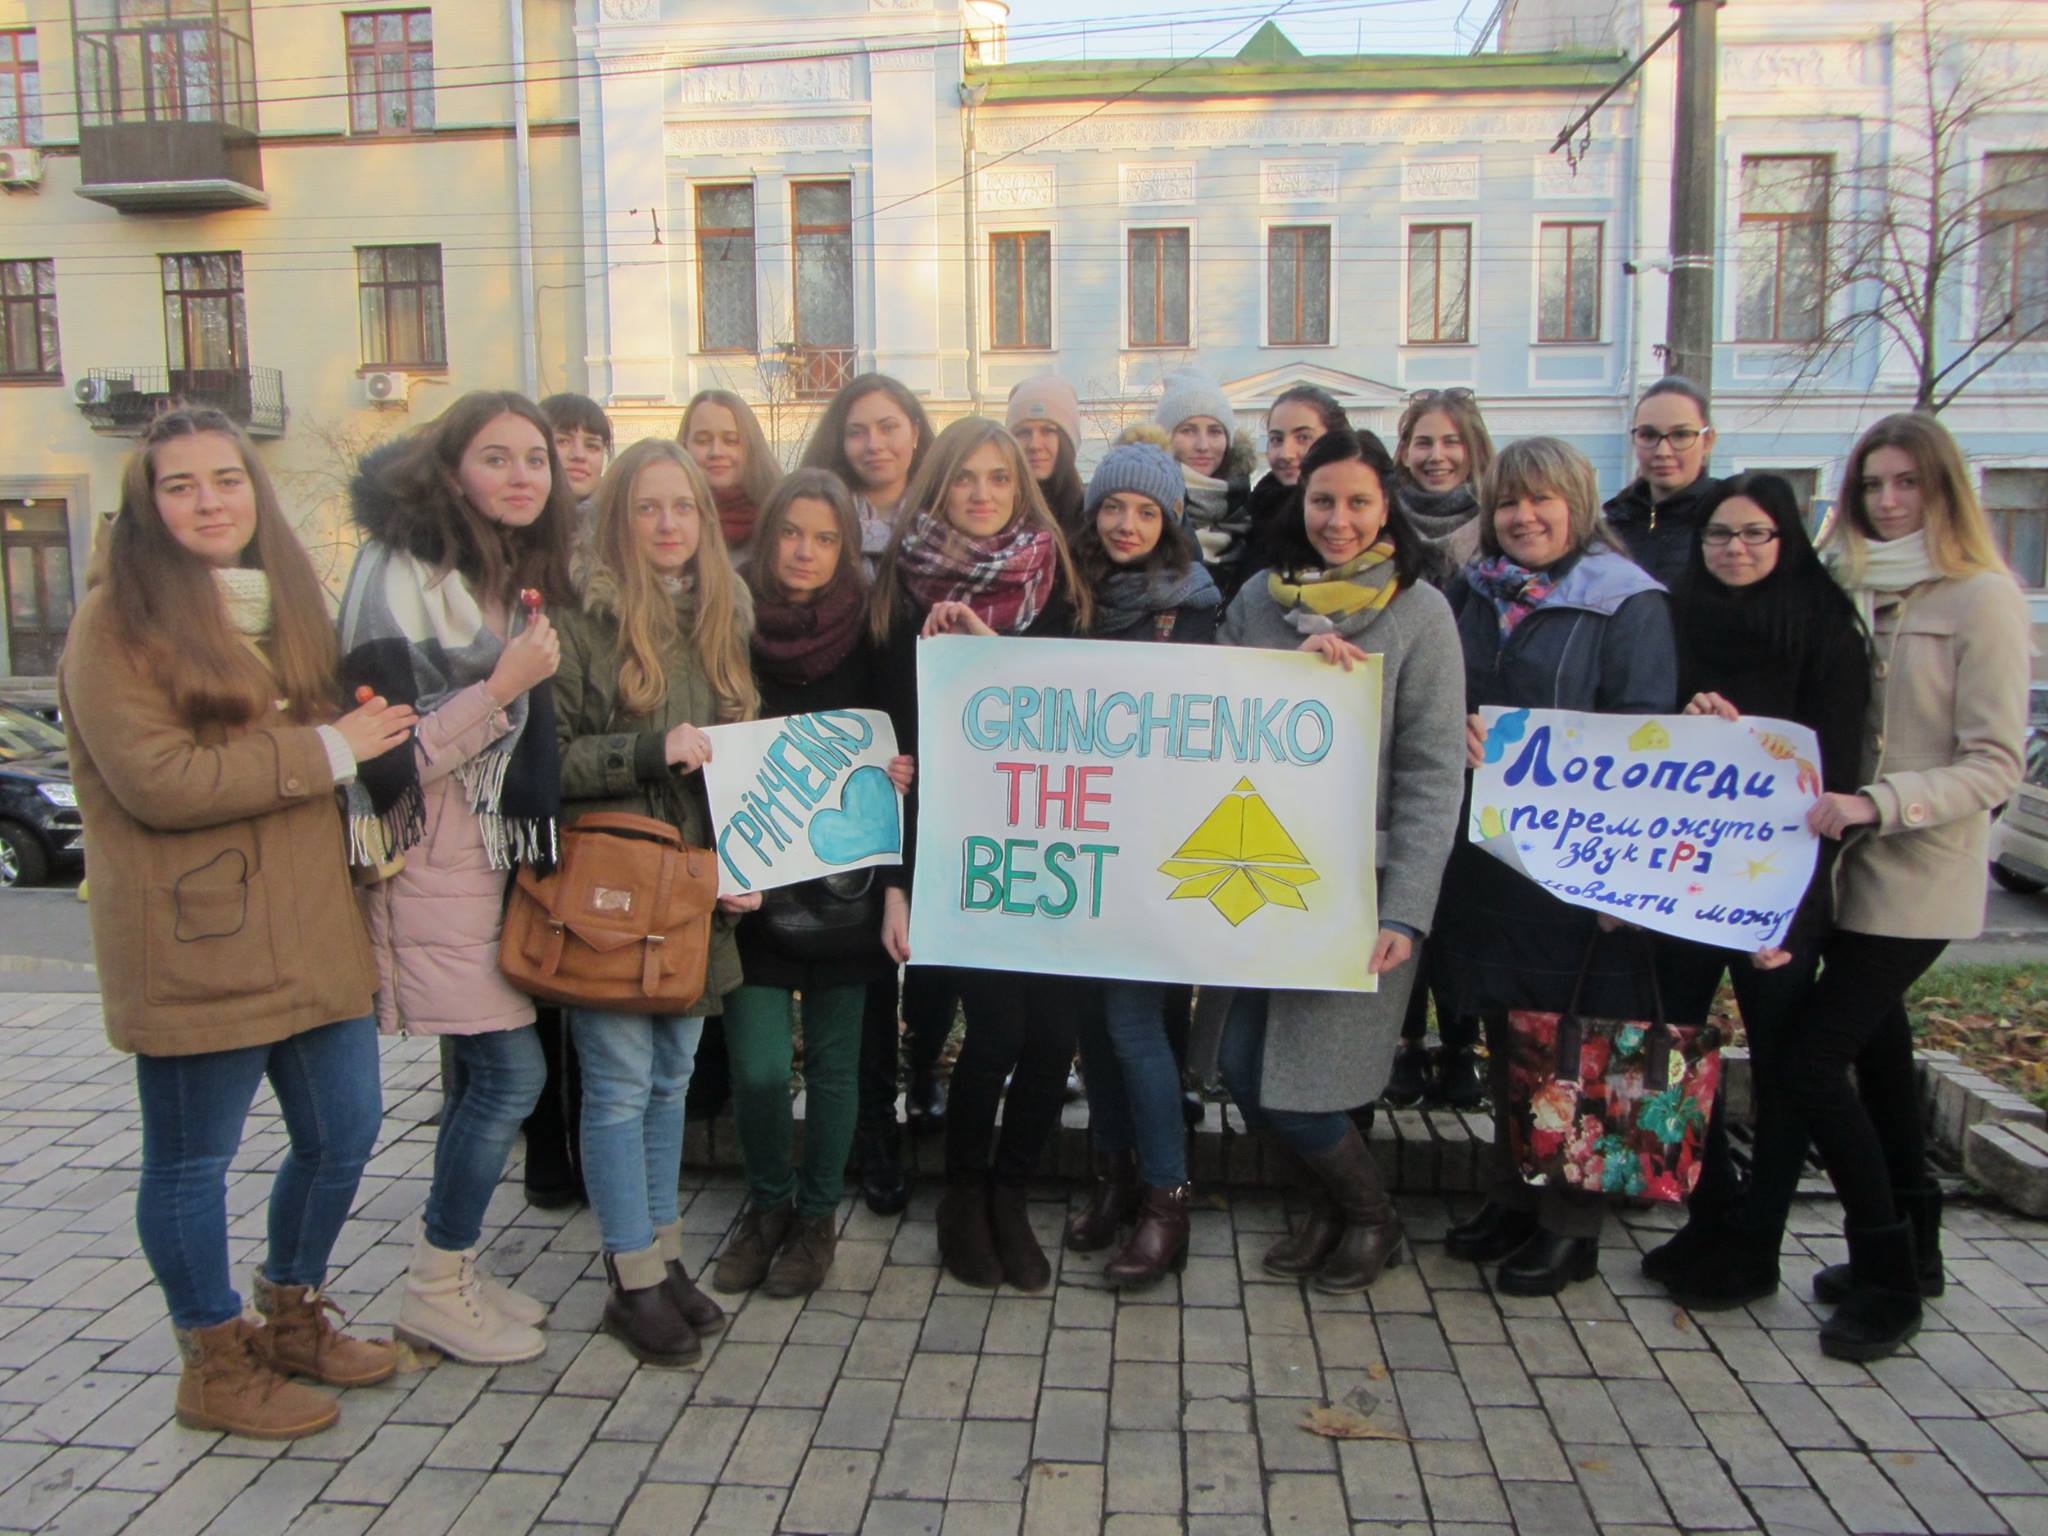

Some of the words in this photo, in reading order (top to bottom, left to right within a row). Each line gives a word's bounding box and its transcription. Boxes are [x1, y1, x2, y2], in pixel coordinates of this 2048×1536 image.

[962, 686, 1334, 766] GRINCHENKO
[1503, 725, 1775, 799] Логопеди
[993, 762, 1114, 831] THE
[960, 836, 1120, 919] BEST
[1556, 837, 1639, 875] звук
